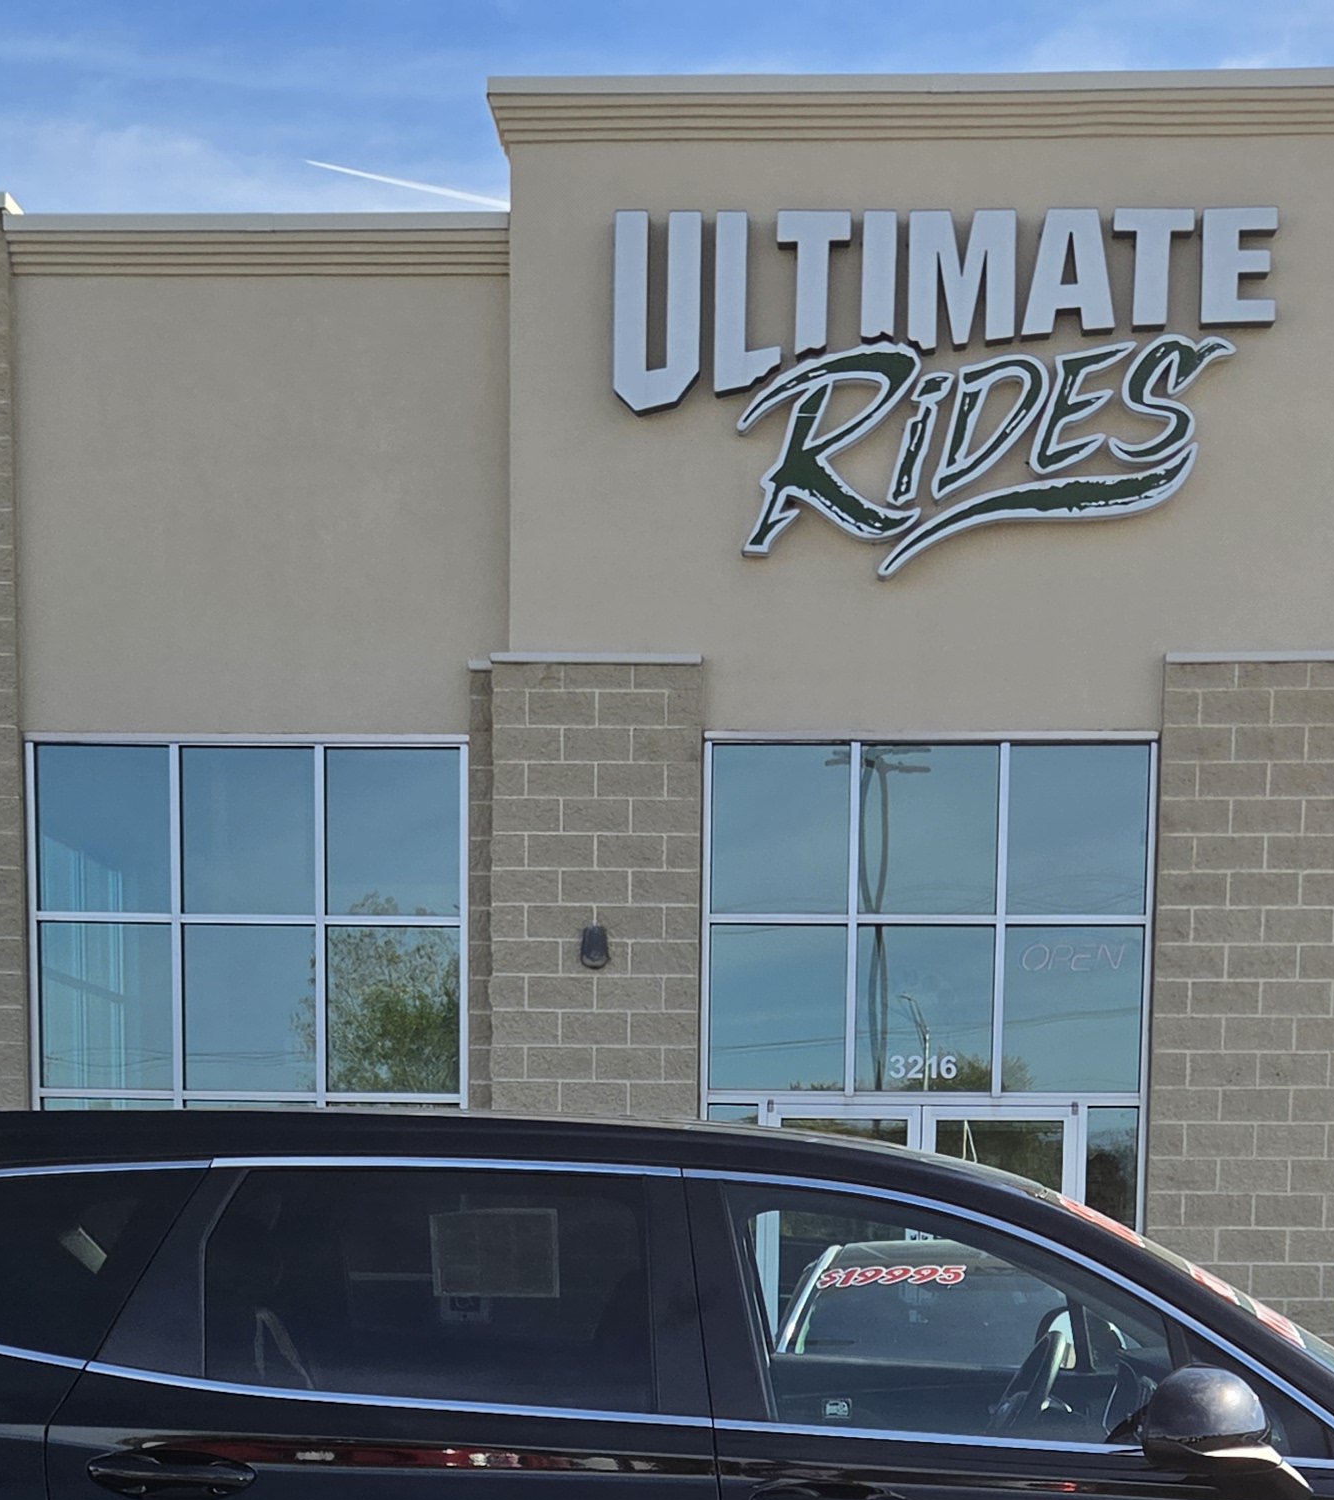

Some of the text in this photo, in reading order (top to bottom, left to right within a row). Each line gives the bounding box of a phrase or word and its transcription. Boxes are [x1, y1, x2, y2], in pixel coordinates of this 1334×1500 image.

[612, 206, 1280, 418] ULTIMATE
[1020, 943, 1126, 973] OPEN
[888, 1054, 958, 1080] 3216
[817, 1265, 966, 1289] $19995
